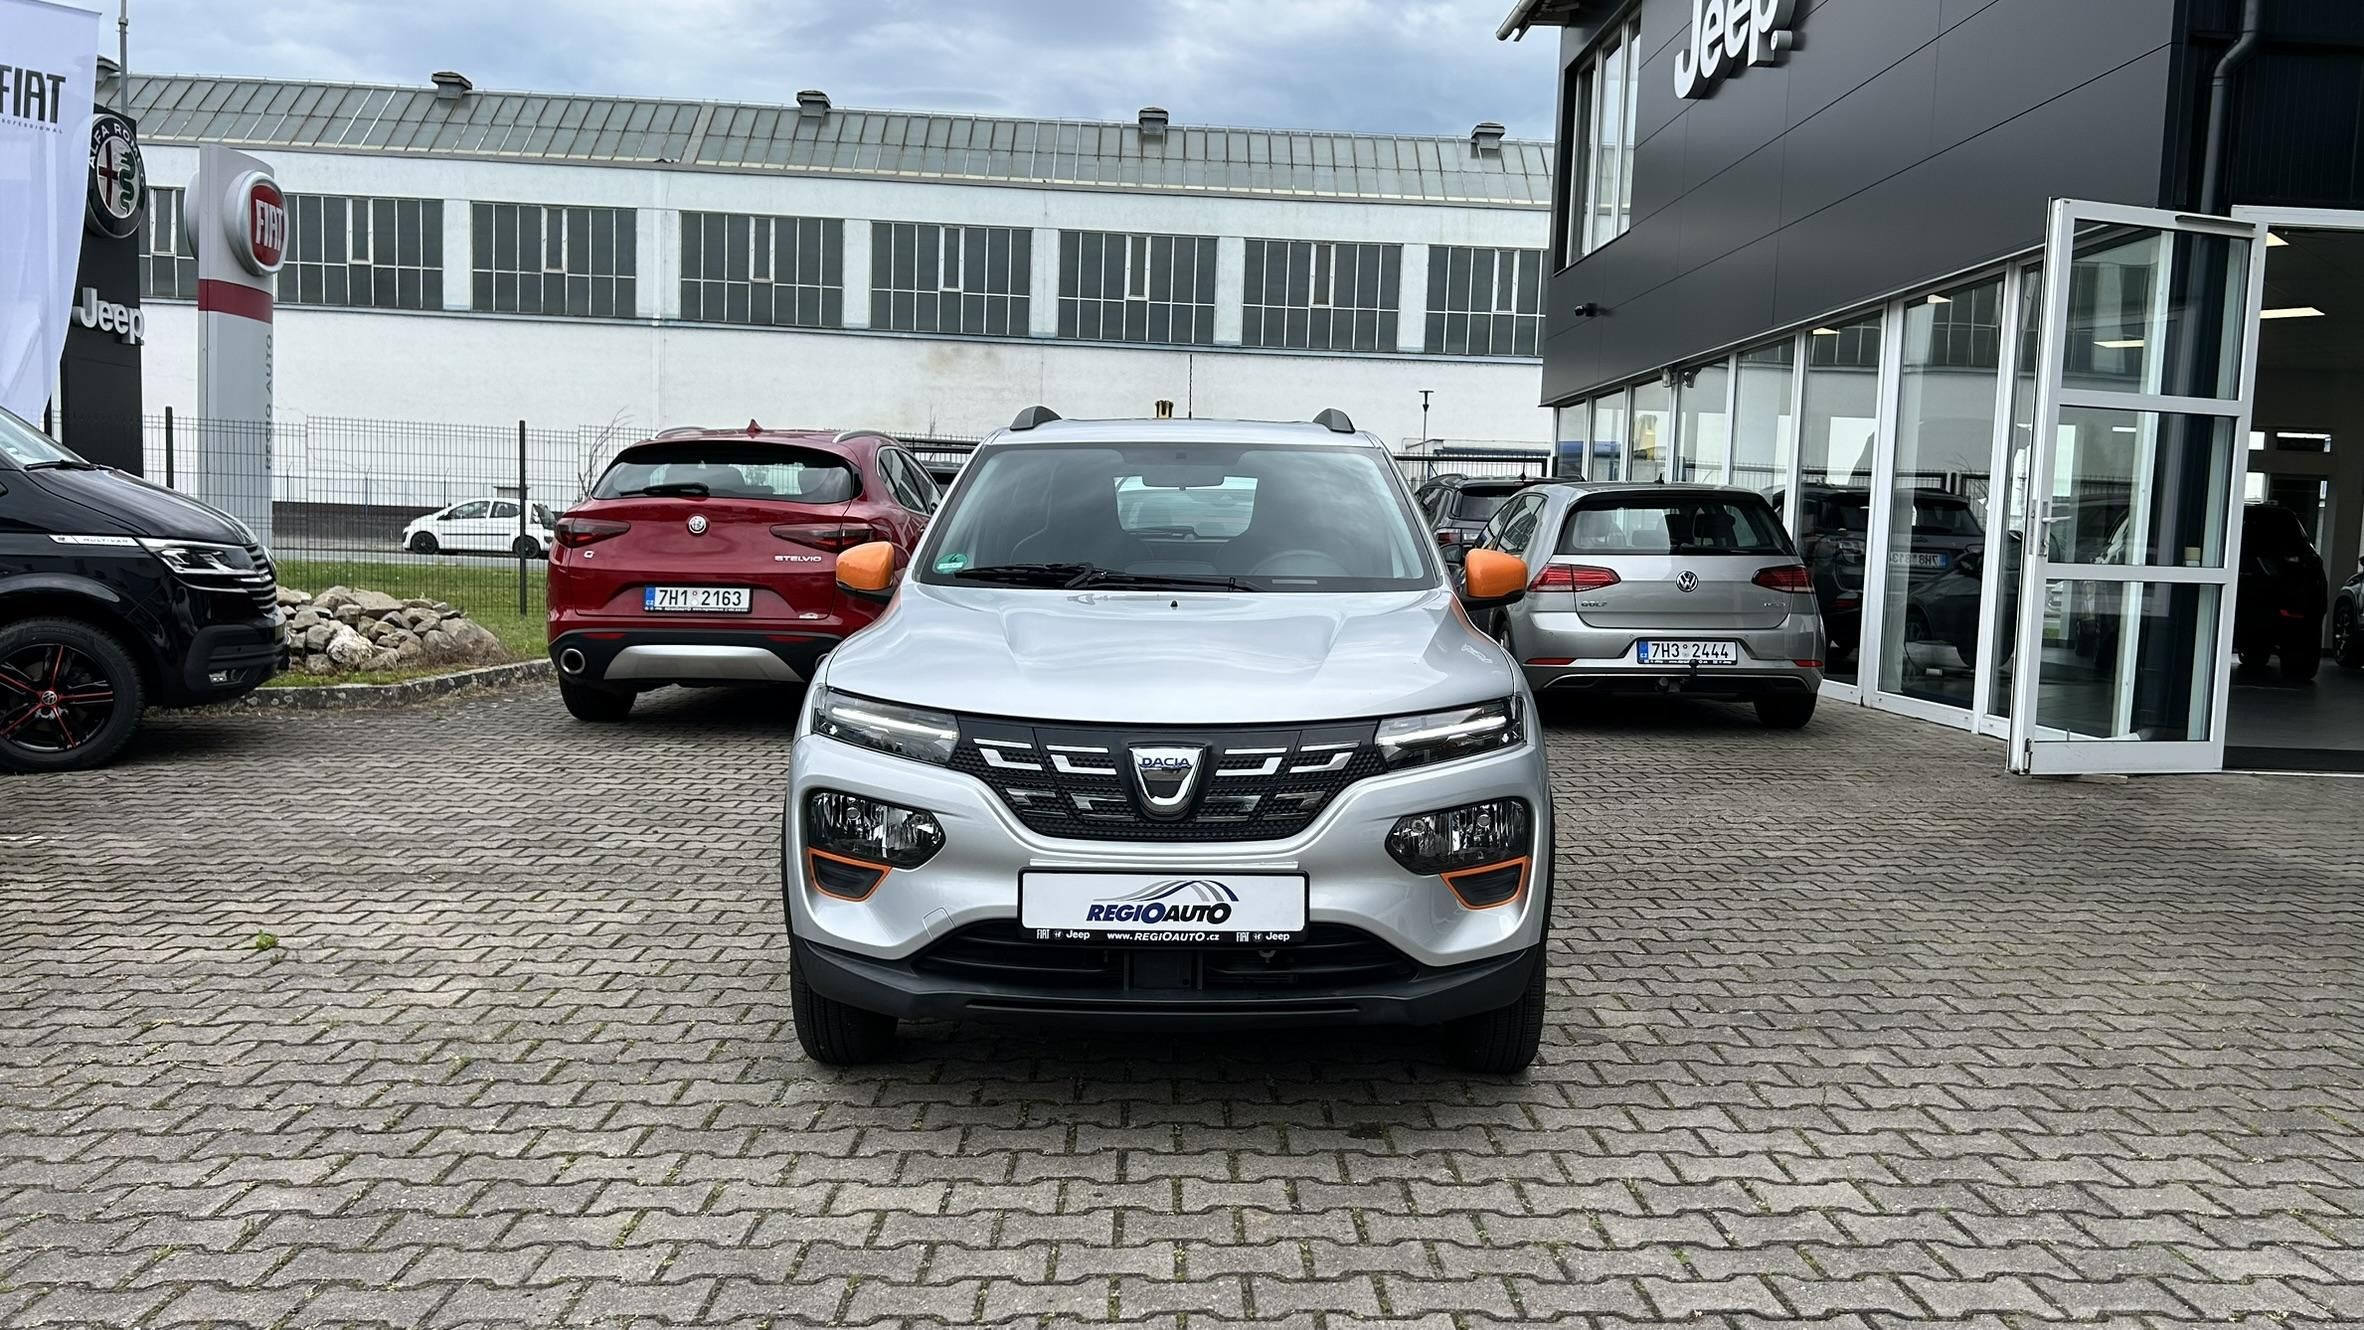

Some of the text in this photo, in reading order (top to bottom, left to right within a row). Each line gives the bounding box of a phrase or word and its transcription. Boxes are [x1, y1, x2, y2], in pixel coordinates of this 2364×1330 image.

[0, 64, 66, 124] FIAT
[1, 118, 62, 134] ROFESSIONAL
[88, 124, 110, 169] ALFA
[255, 199, 283, 252] FIAT
[79, 287, 145, 345] Jeep
[659, 590, 742, 606] 7H1 2163
[1651, 643, 1729, 658] 7H3 2444
[1141, 757, 1191, 767] DACIA
[1086, 902, 1232, 924] REGIOAUTO
[1036, 928, 1090, 940] FIAT Jeep
[1236, 931, 1290, 942] FIAT Jeep
